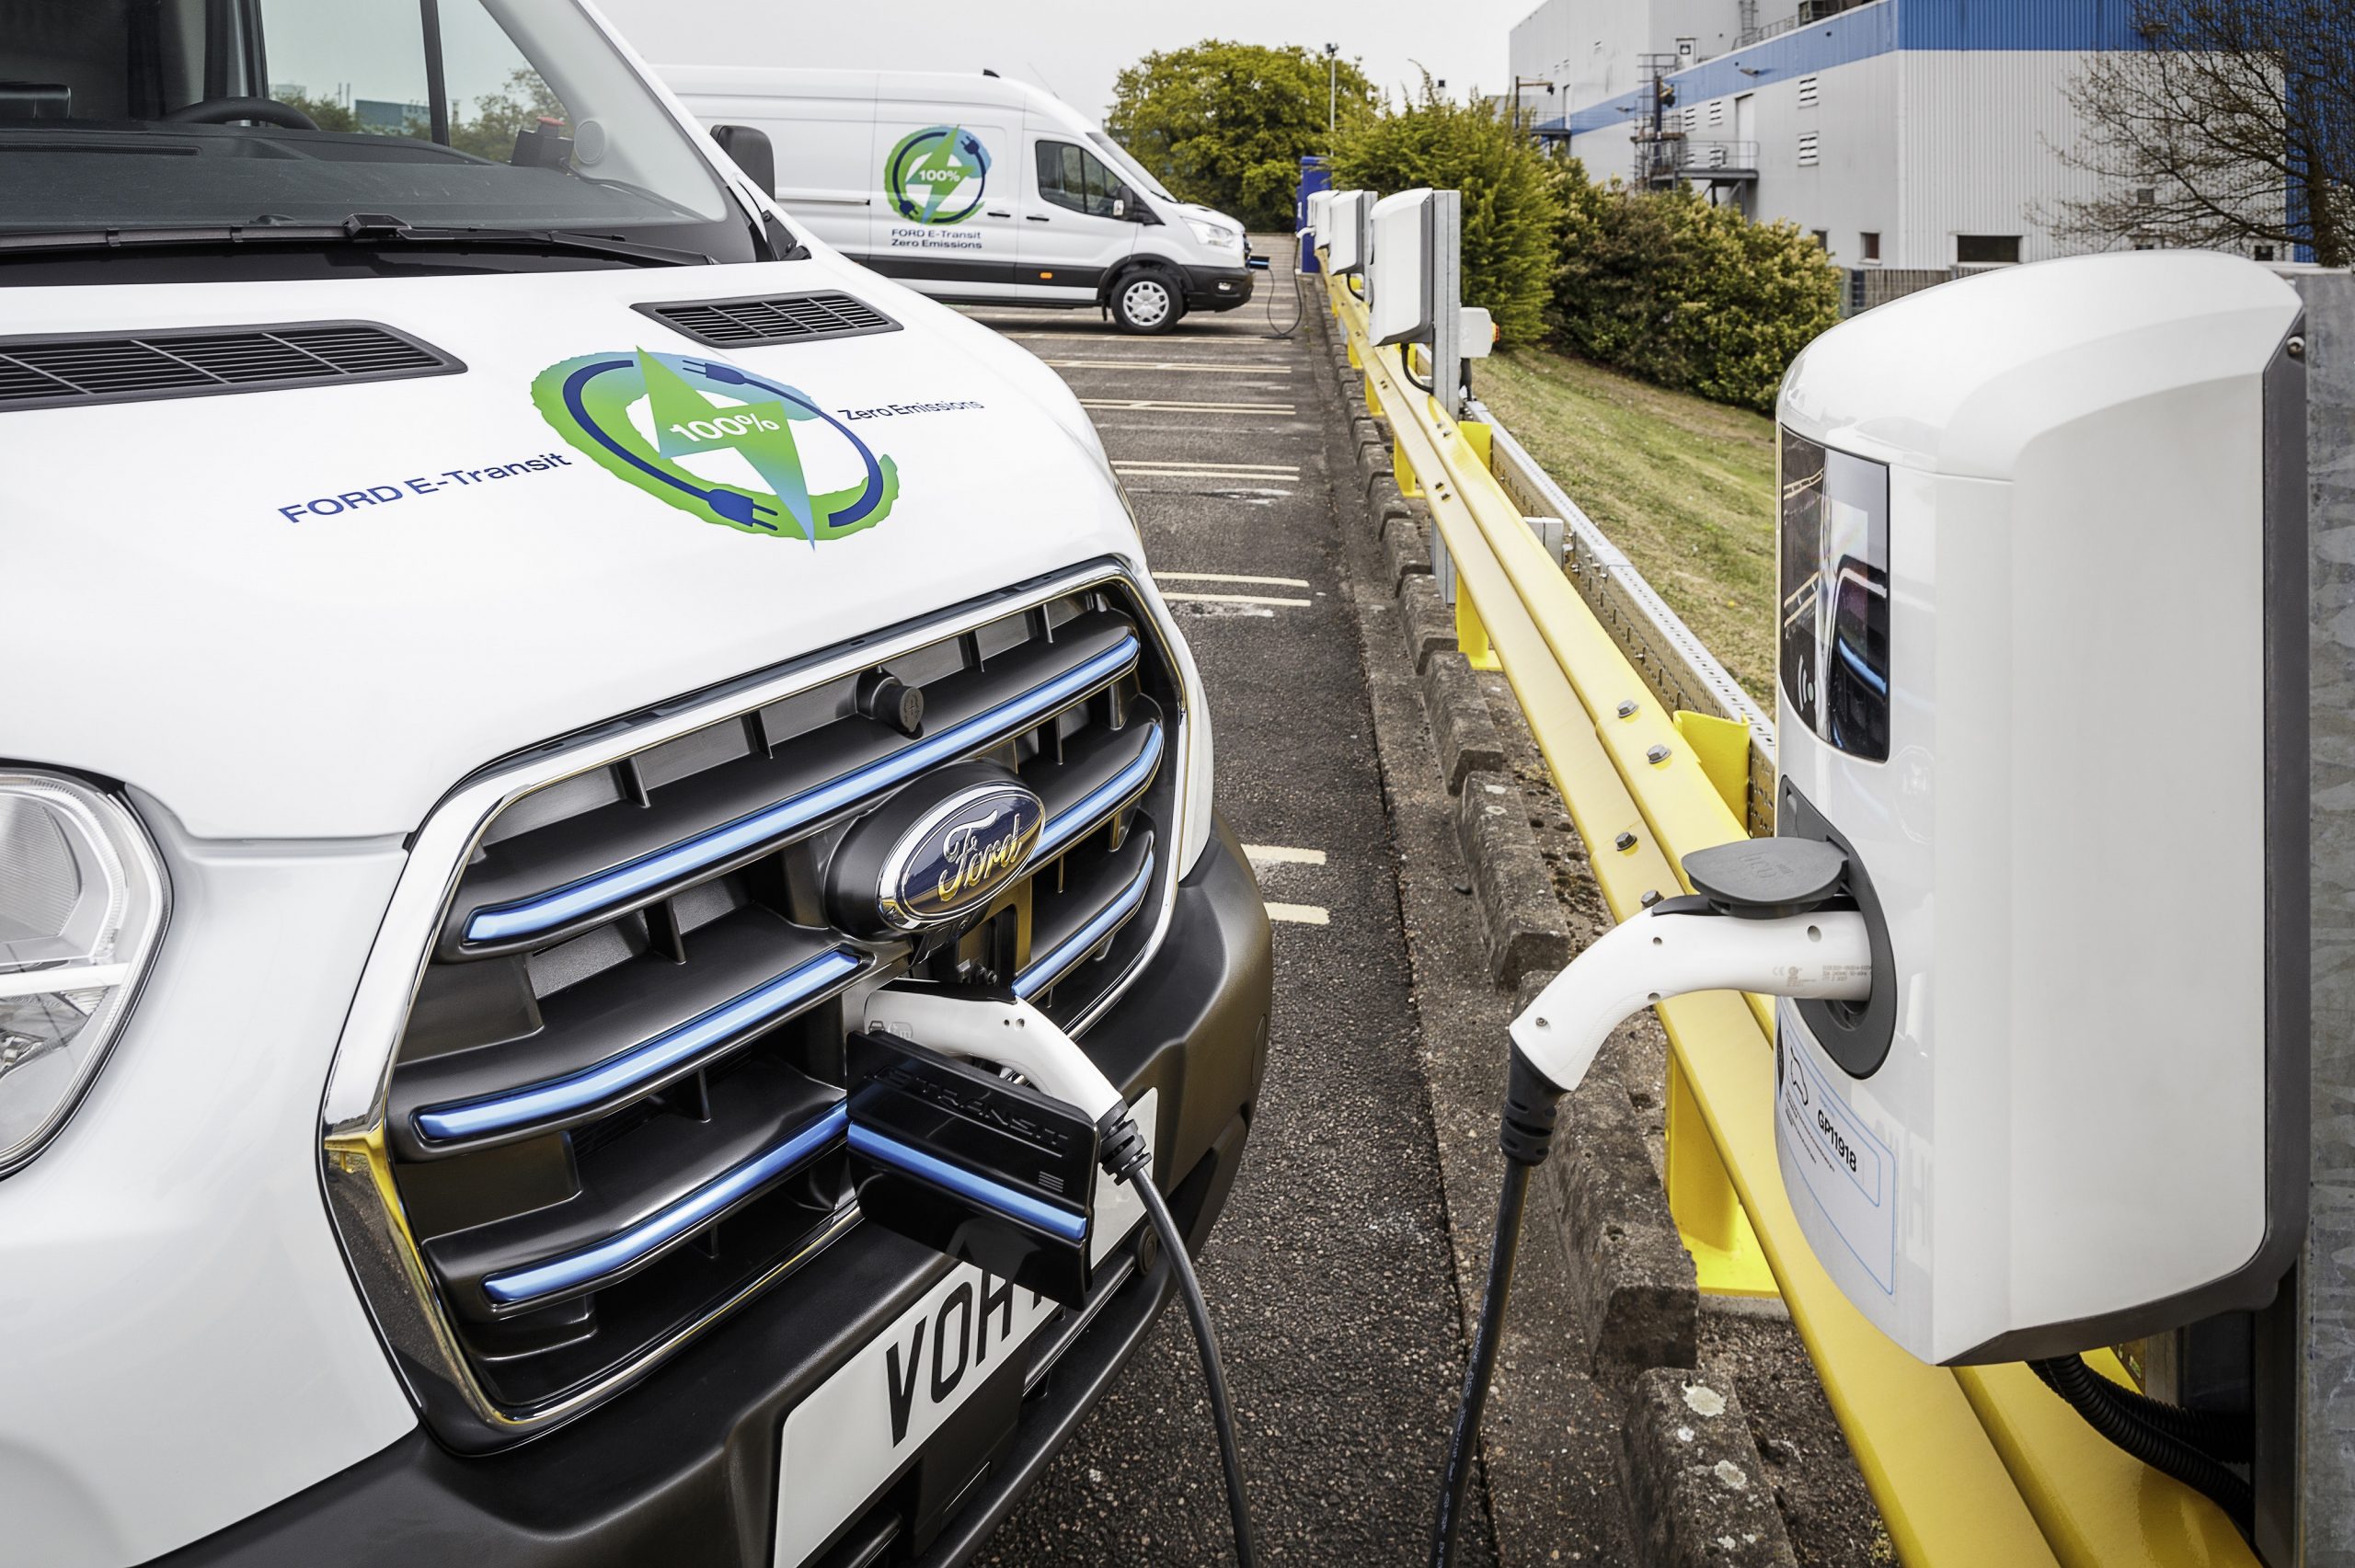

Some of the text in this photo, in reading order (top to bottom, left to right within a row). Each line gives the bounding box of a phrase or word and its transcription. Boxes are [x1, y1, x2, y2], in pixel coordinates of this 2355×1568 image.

[919, 169, 960, 182] 100%
[891, 229, 981, 239] FORD E-Transit
[891, 239, 982, 249] Zero Emissions
[837, 400, 985, 421] Zero Emissions
[670, 413, 780, 443] 100%
[278, 452, 572, 523] FORD E-Transit
[938, 809, 1023, 902] Ford
[1818, 1109, 1857, 1173] GP11918
[886, 1267, 1042, 1449] VOH
